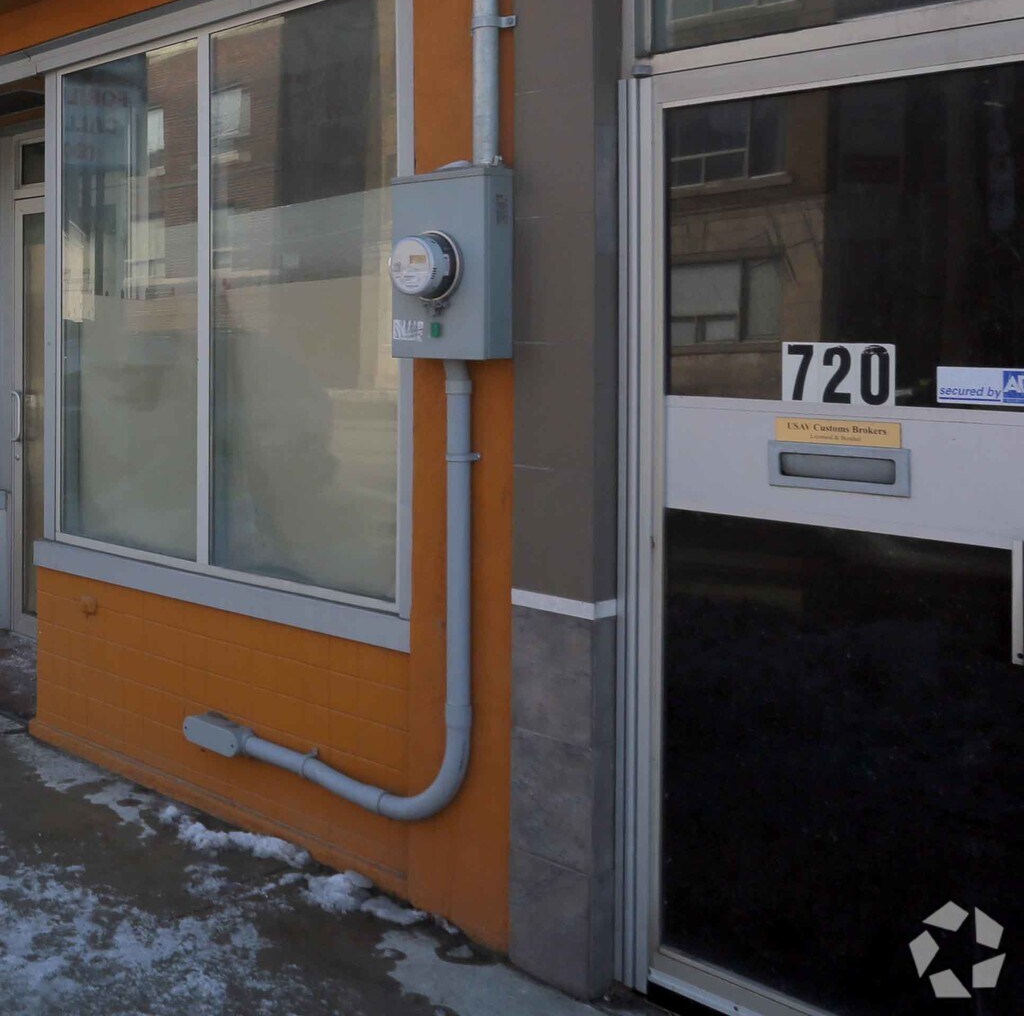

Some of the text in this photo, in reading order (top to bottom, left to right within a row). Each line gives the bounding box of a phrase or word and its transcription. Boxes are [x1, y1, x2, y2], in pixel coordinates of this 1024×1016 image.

[787, 344, 890, 406] 720
[939, 387, 984, 397] secured
[987, 387, 1002, 399] by
[813, 424, 850, 433] Customs
[852, 426, 887, 436] Brokers
